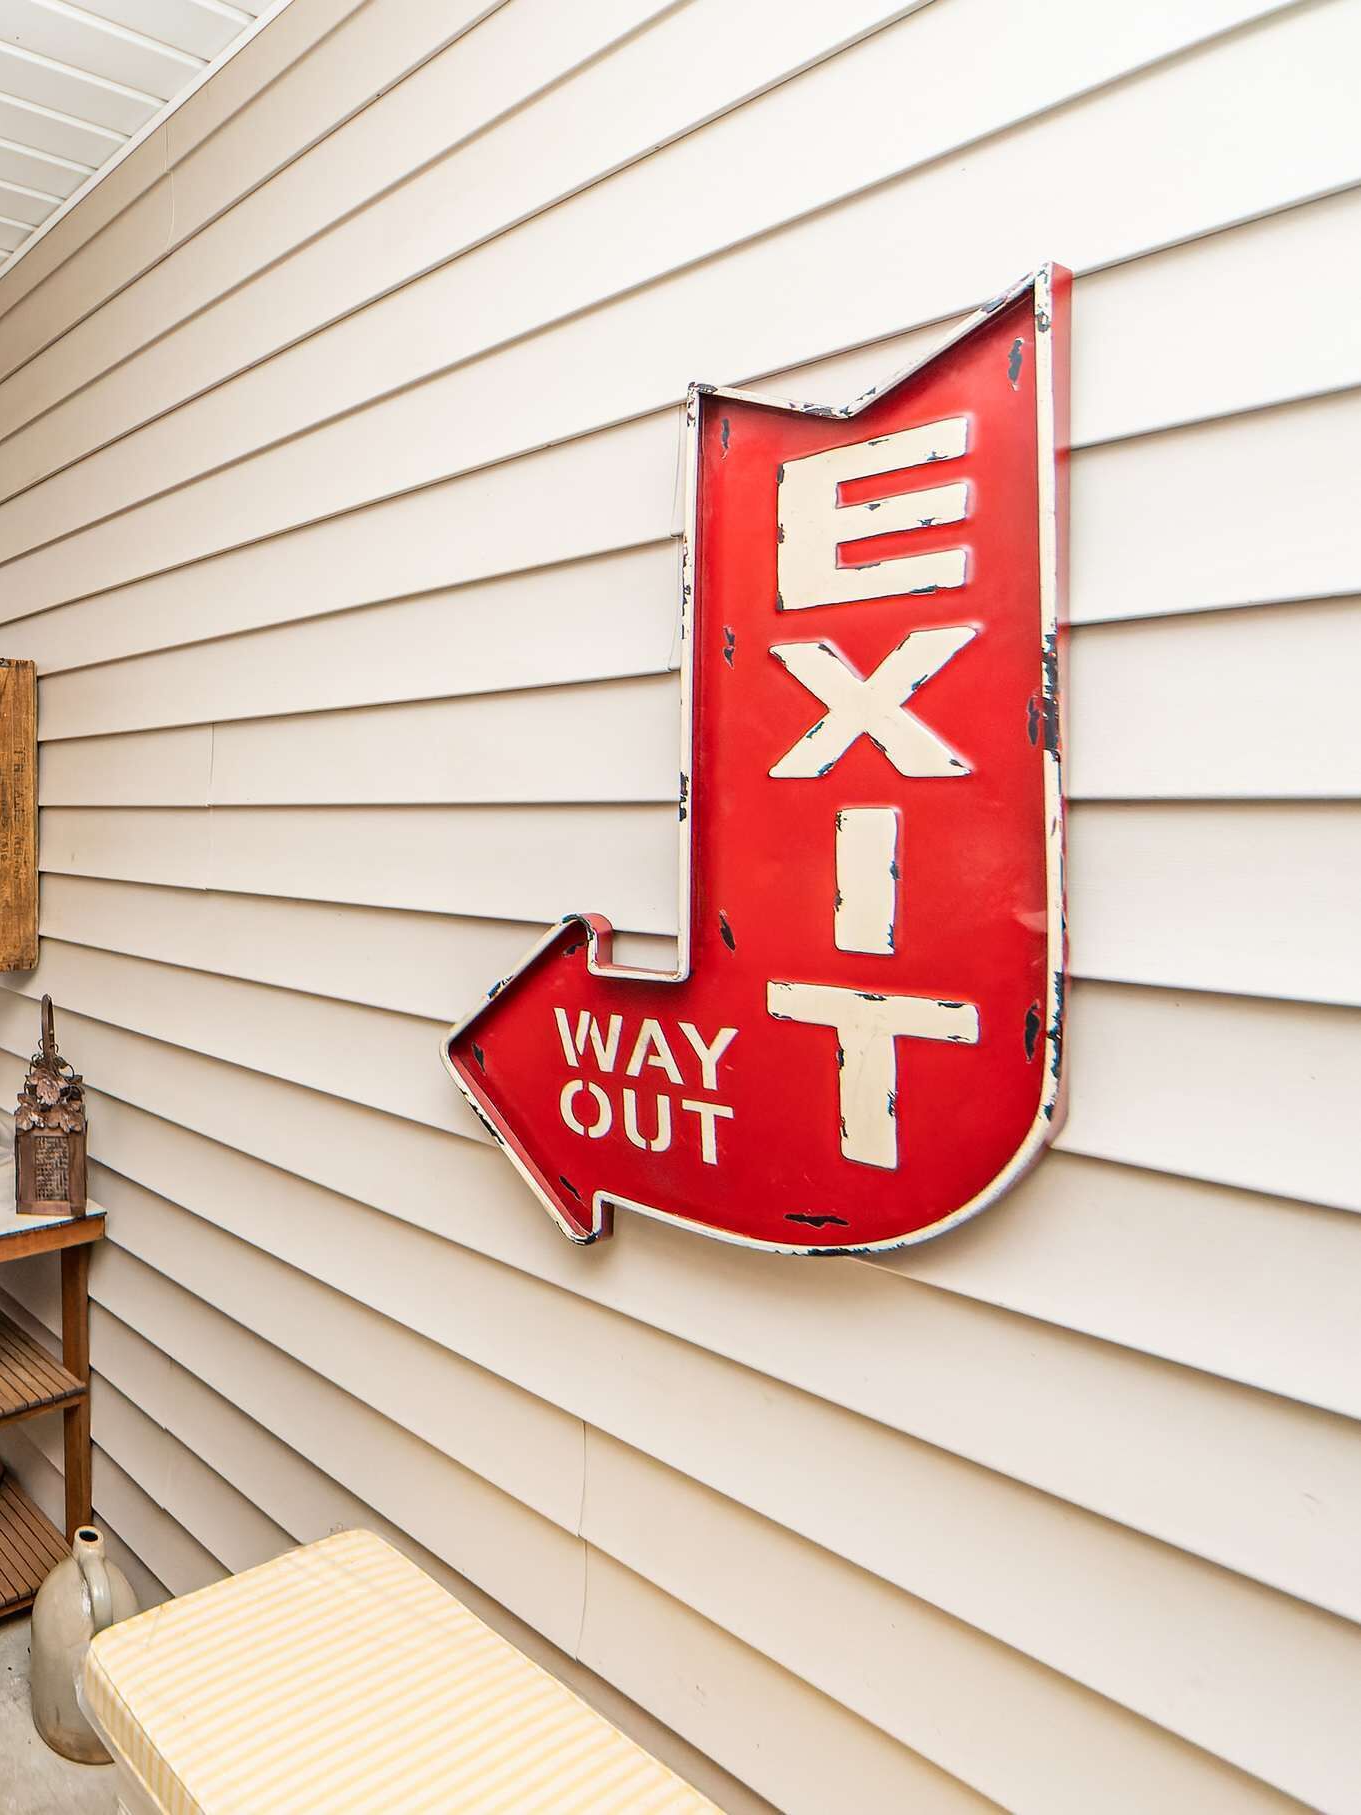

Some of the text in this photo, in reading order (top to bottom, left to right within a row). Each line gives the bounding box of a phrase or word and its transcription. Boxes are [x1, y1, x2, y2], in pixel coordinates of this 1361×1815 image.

[766, 414, 981, 1171] EXIT
[553, 1007, 740, 1091] WAY
[559, 1079, 735, 1166] OUT
